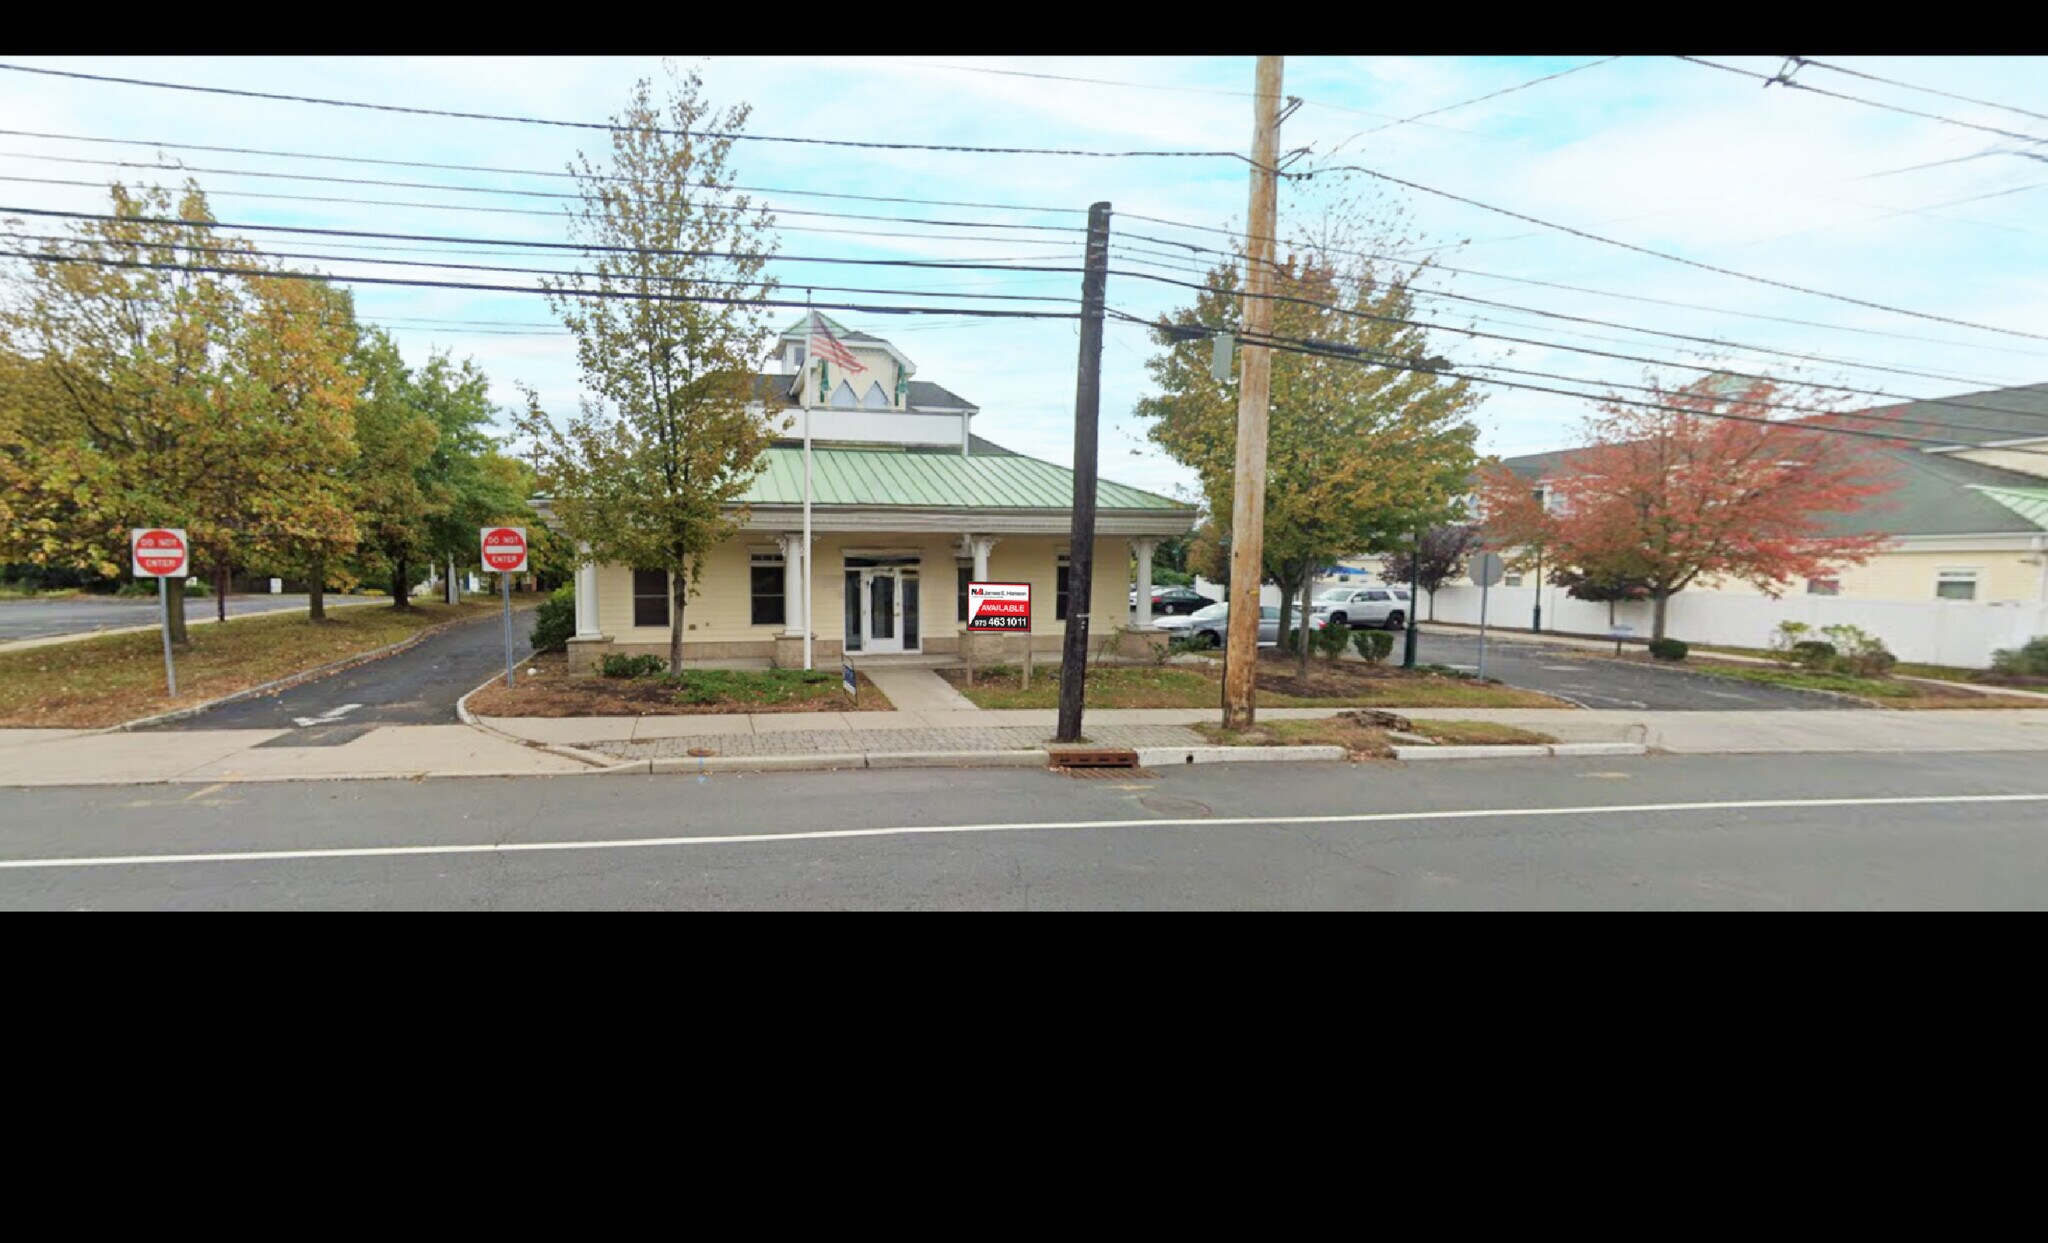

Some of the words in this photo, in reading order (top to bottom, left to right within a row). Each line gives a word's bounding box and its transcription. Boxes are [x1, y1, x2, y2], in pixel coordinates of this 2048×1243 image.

[140, 538, 154, 547] DO
[157, 538, 176, 547] NOT
[488, 536, 499, 544] DO
[503, 536, 518, 544] NOT
[145, 559, 176, 568] ENTER
[492, 555, 517, 564] ENTER
[988, 617, 1005, 626] 463
[1006, 617, 1026, 626] 1011
